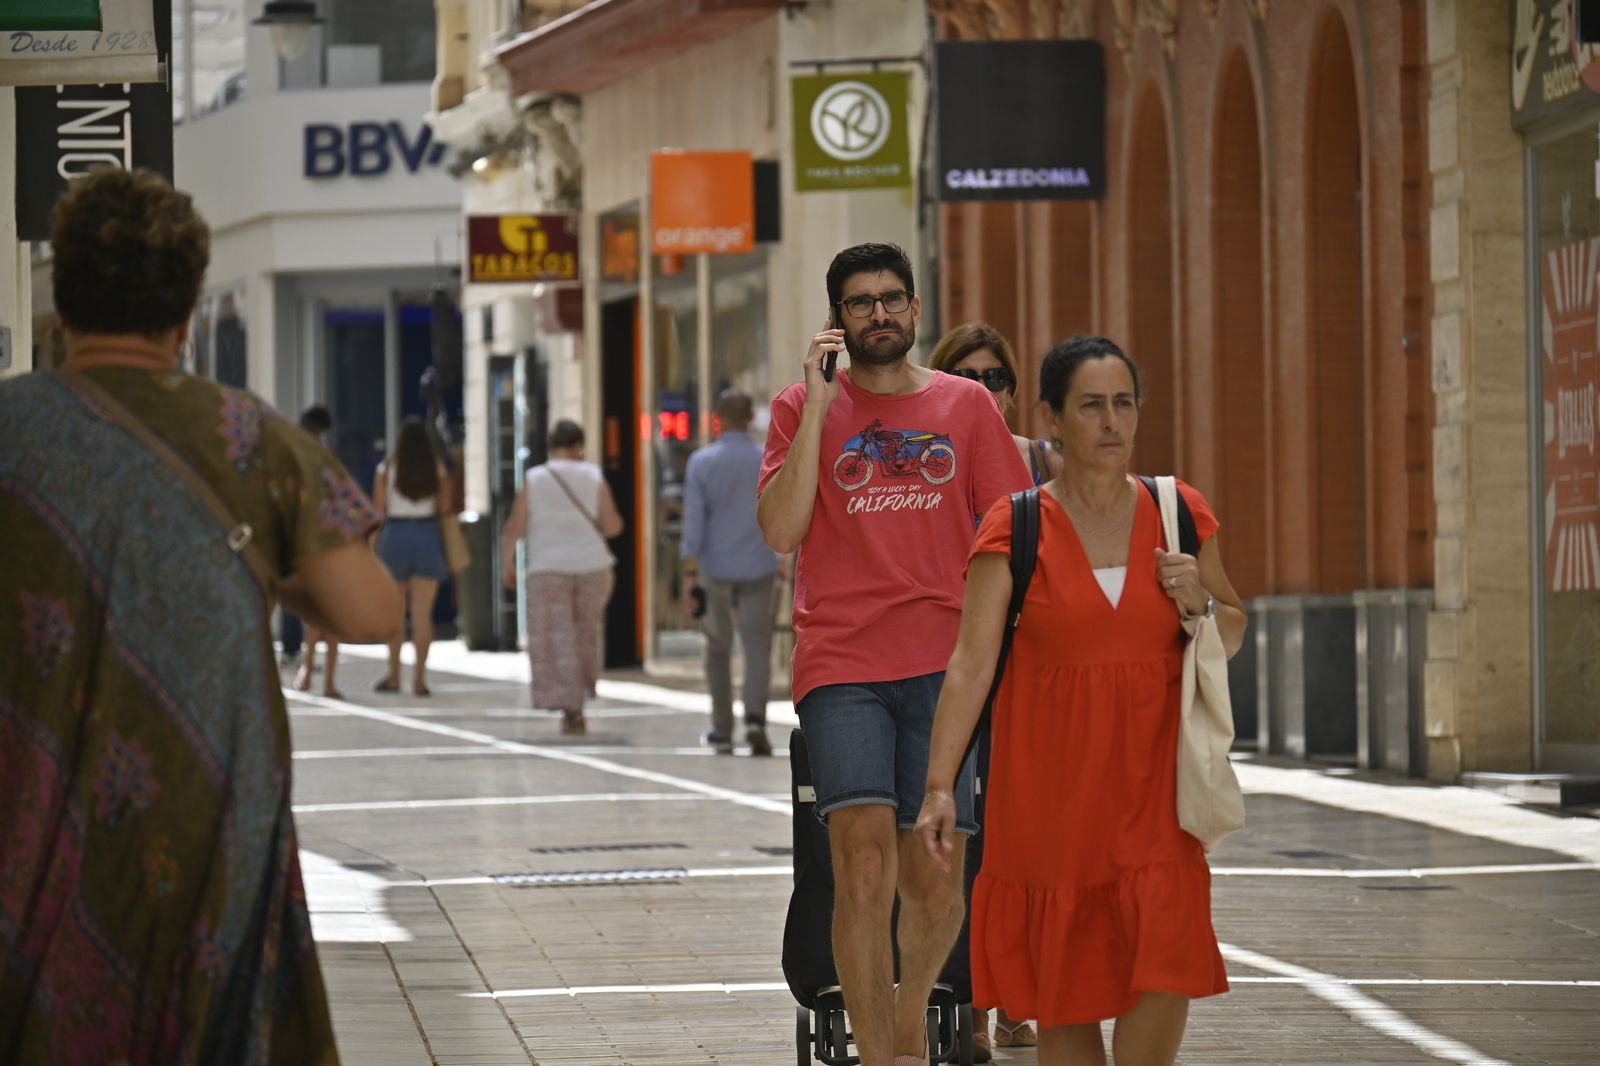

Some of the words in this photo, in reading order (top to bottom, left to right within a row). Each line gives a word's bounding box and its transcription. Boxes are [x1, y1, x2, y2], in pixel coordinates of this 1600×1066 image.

[10, 31, 79, 53] Desde
[91, 31, 154, 52] 1928
[946, 168, 1091, 189] CALZEDONIA
[655, 227, 744, 252] orange
[473, 253, 576, 277] TABACOS
[908, 484, 922, 492] DAY
[847, 492, 943, 514] CALIFORNIA
